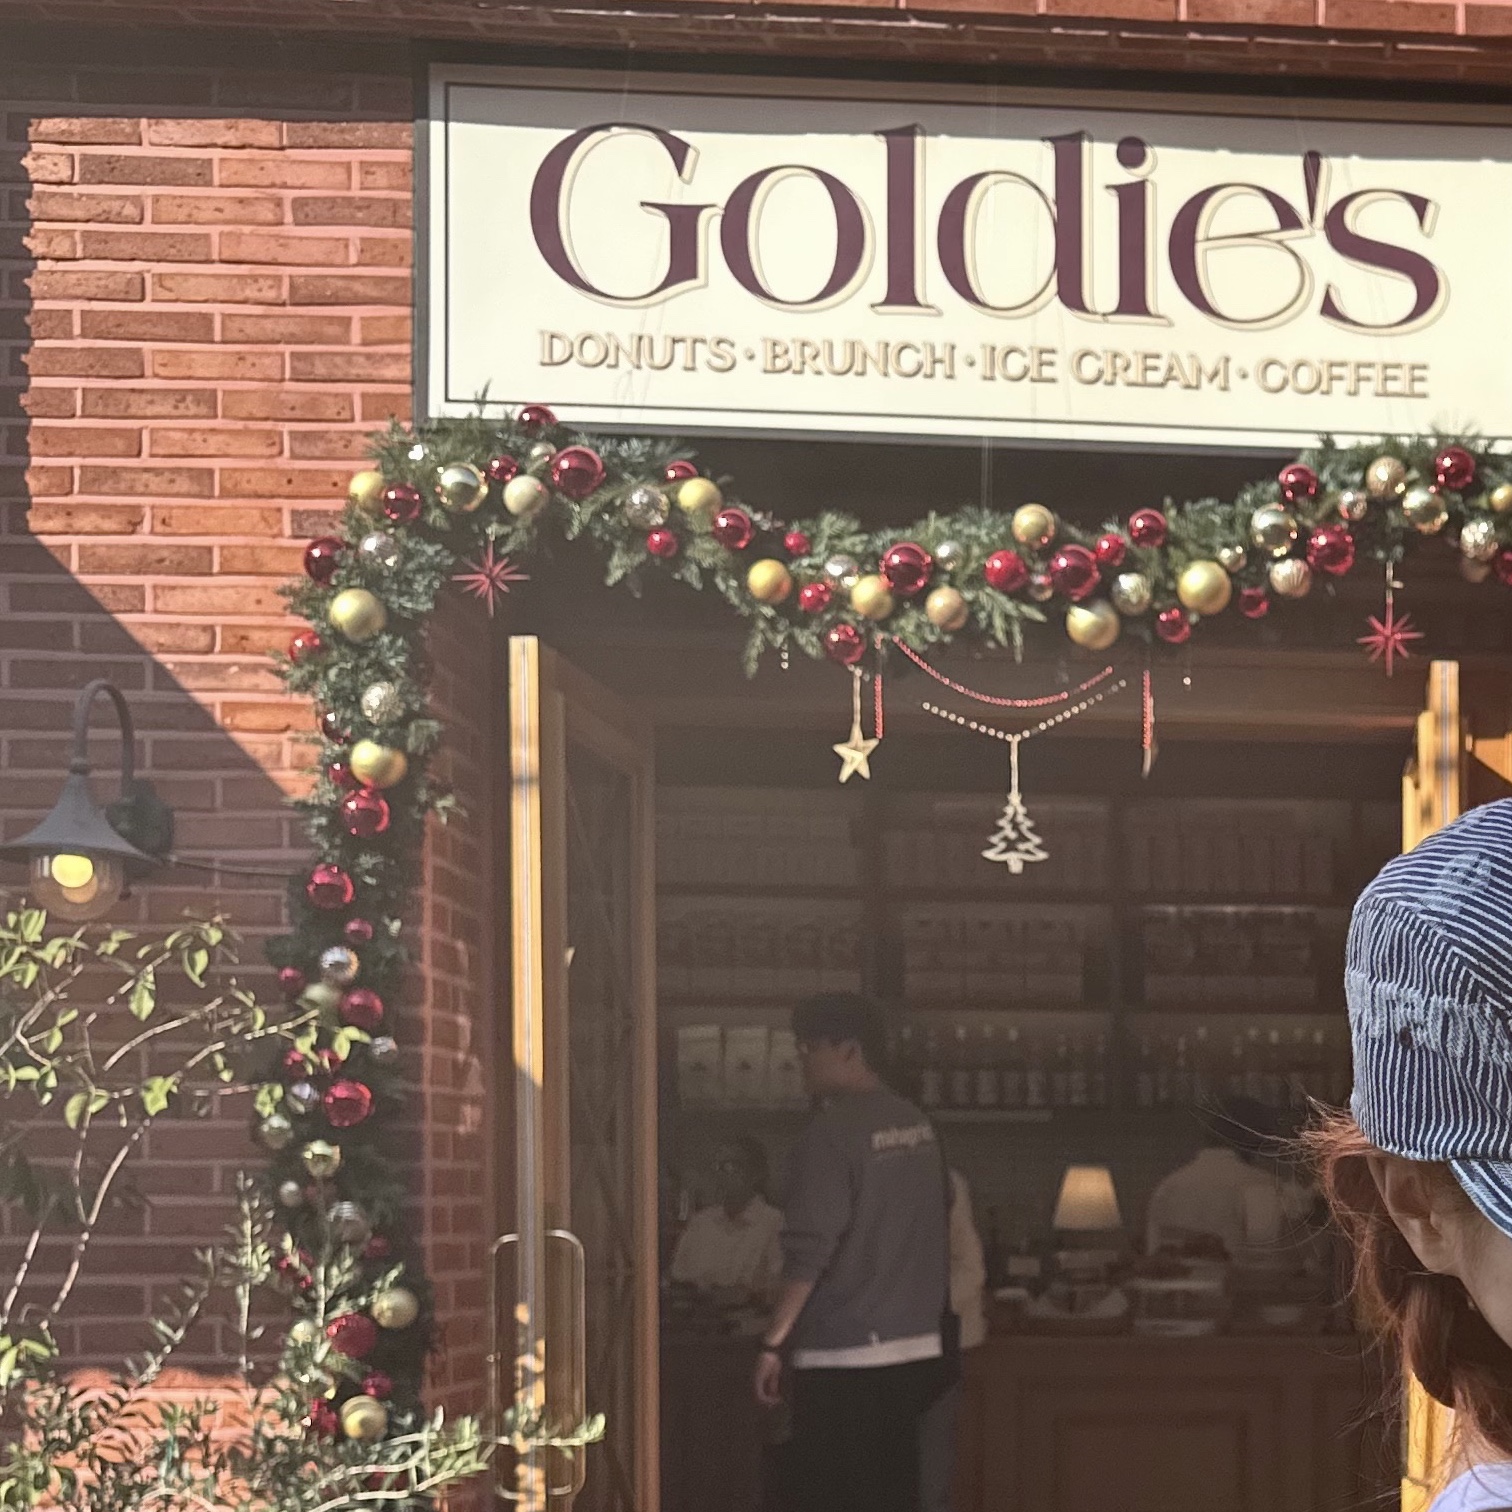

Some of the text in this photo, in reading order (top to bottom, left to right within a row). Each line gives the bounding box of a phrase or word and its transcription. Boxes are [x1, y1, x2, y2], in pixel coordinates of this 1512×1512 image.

[530, 121, 1451, 337] Goldie's
[539, 329, 1430, 398] DONUTS BRUNCH ICE CREAM COFFEE
